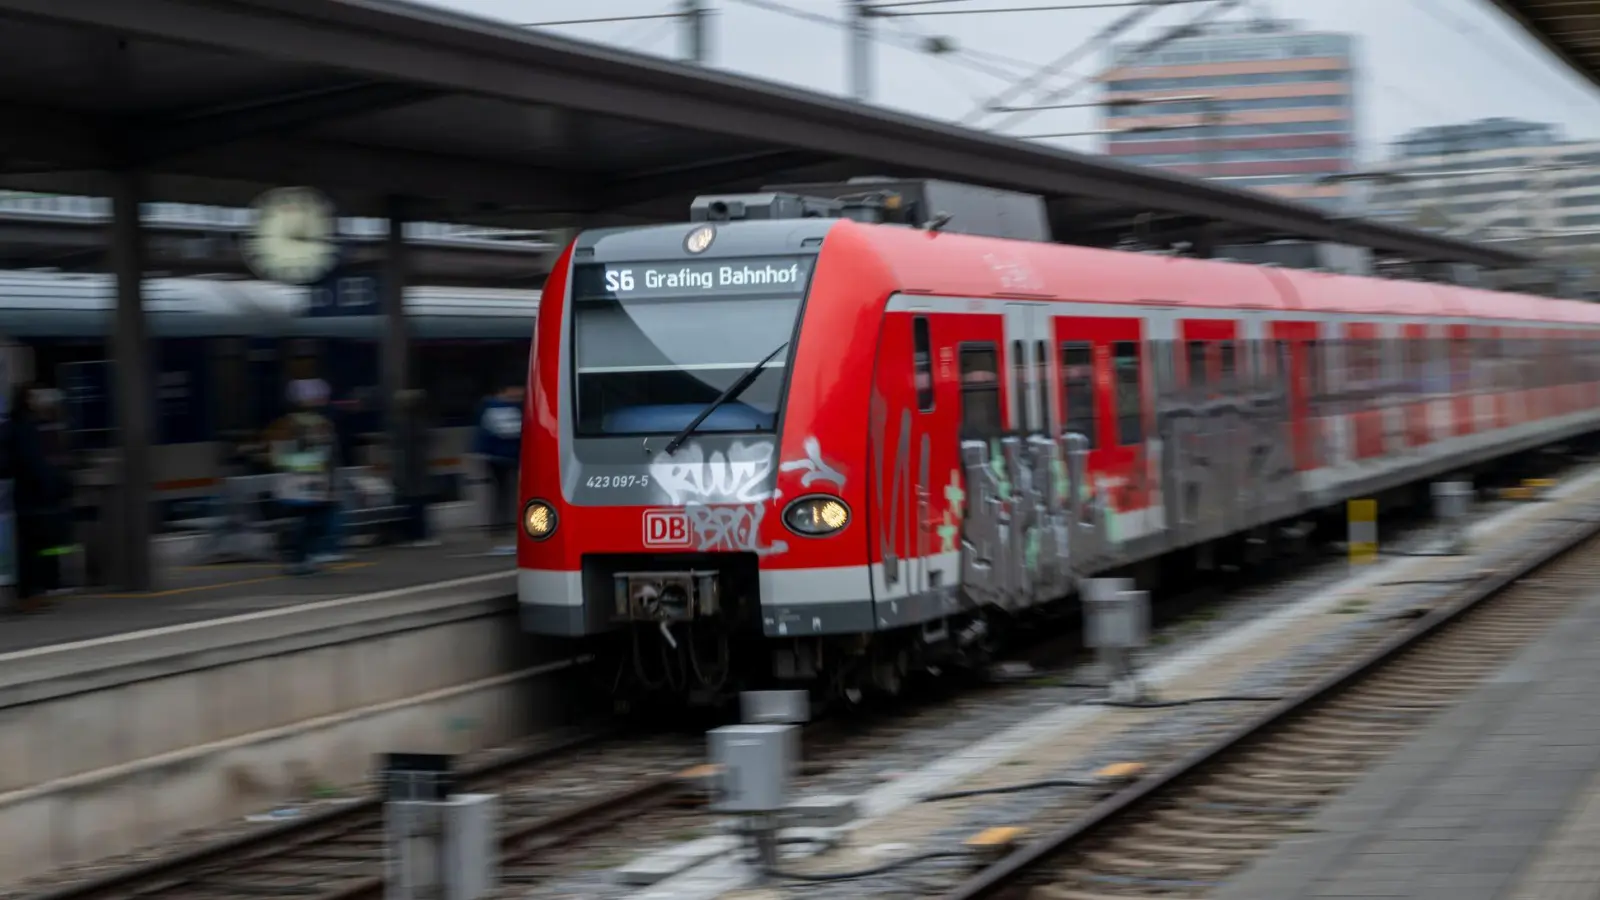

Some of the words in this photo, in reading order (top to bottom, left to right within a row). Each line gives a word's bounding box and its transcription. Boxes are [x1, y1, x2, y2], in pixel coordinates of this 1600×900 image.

[605, 269, 635, 291] S6
[645, 267, 713, 288] Grafing
[719, 264, 799, 286] Bahnhof
[586, 475, 611, 488] 423
[612, 474, 649, 488] 097-5
[649, 516, 687, 541] DB
